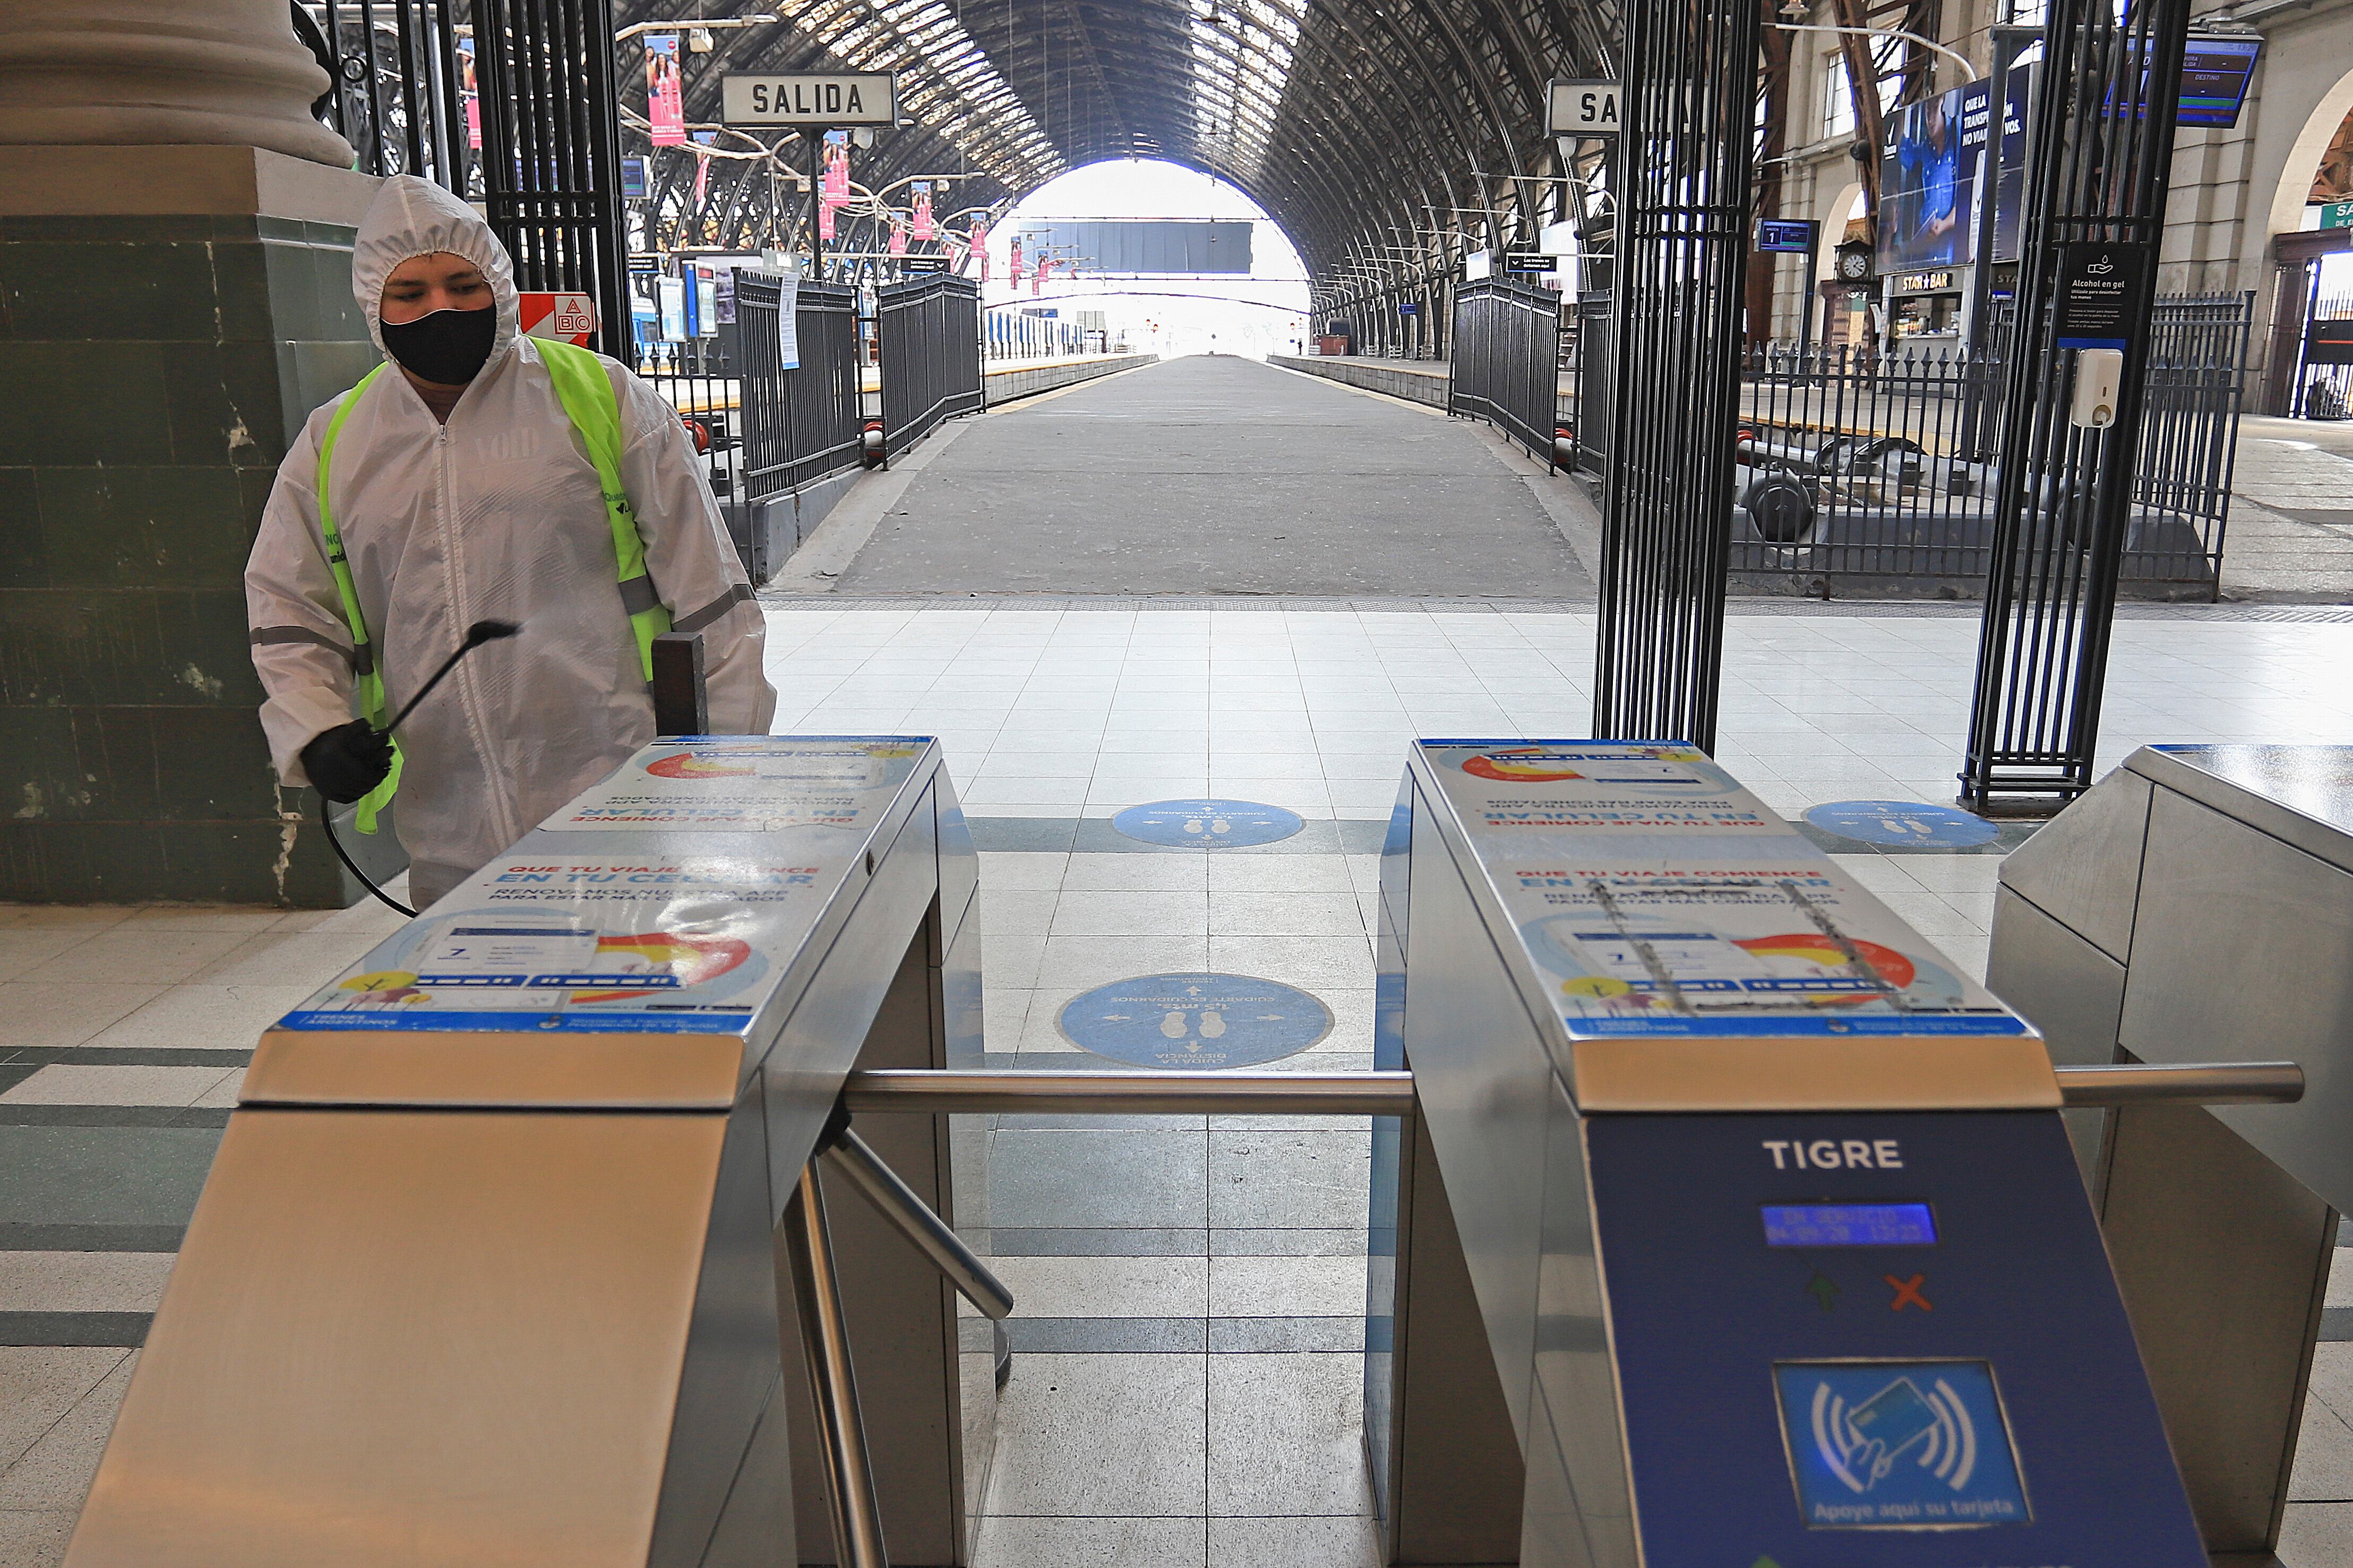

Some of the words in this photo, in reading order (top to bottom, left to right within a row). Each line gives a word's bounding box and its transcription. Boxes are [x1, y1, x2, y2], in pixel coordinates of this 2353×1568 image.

[753, 84, 863, 113] SALIDA
[1965, 97, 1978, 113] QUE
[1978, 94, 1987, 108] LA
[1962, 132, 1972, 146] NO
[1770, 232, 1775, 243] 1
[1903, 275, 1922, 291] STAR
[1929, 273, 1947, 288] BAR
[2112, 281, 2125, 289] gel
[1762, 1140, 1903, 1169] TIGRE
[1814, 1503, 1874, 1522] Apoye
[1925, 1504, 1947, 1517] su
[1951, 1499, 2014, 1518] tarjeta
